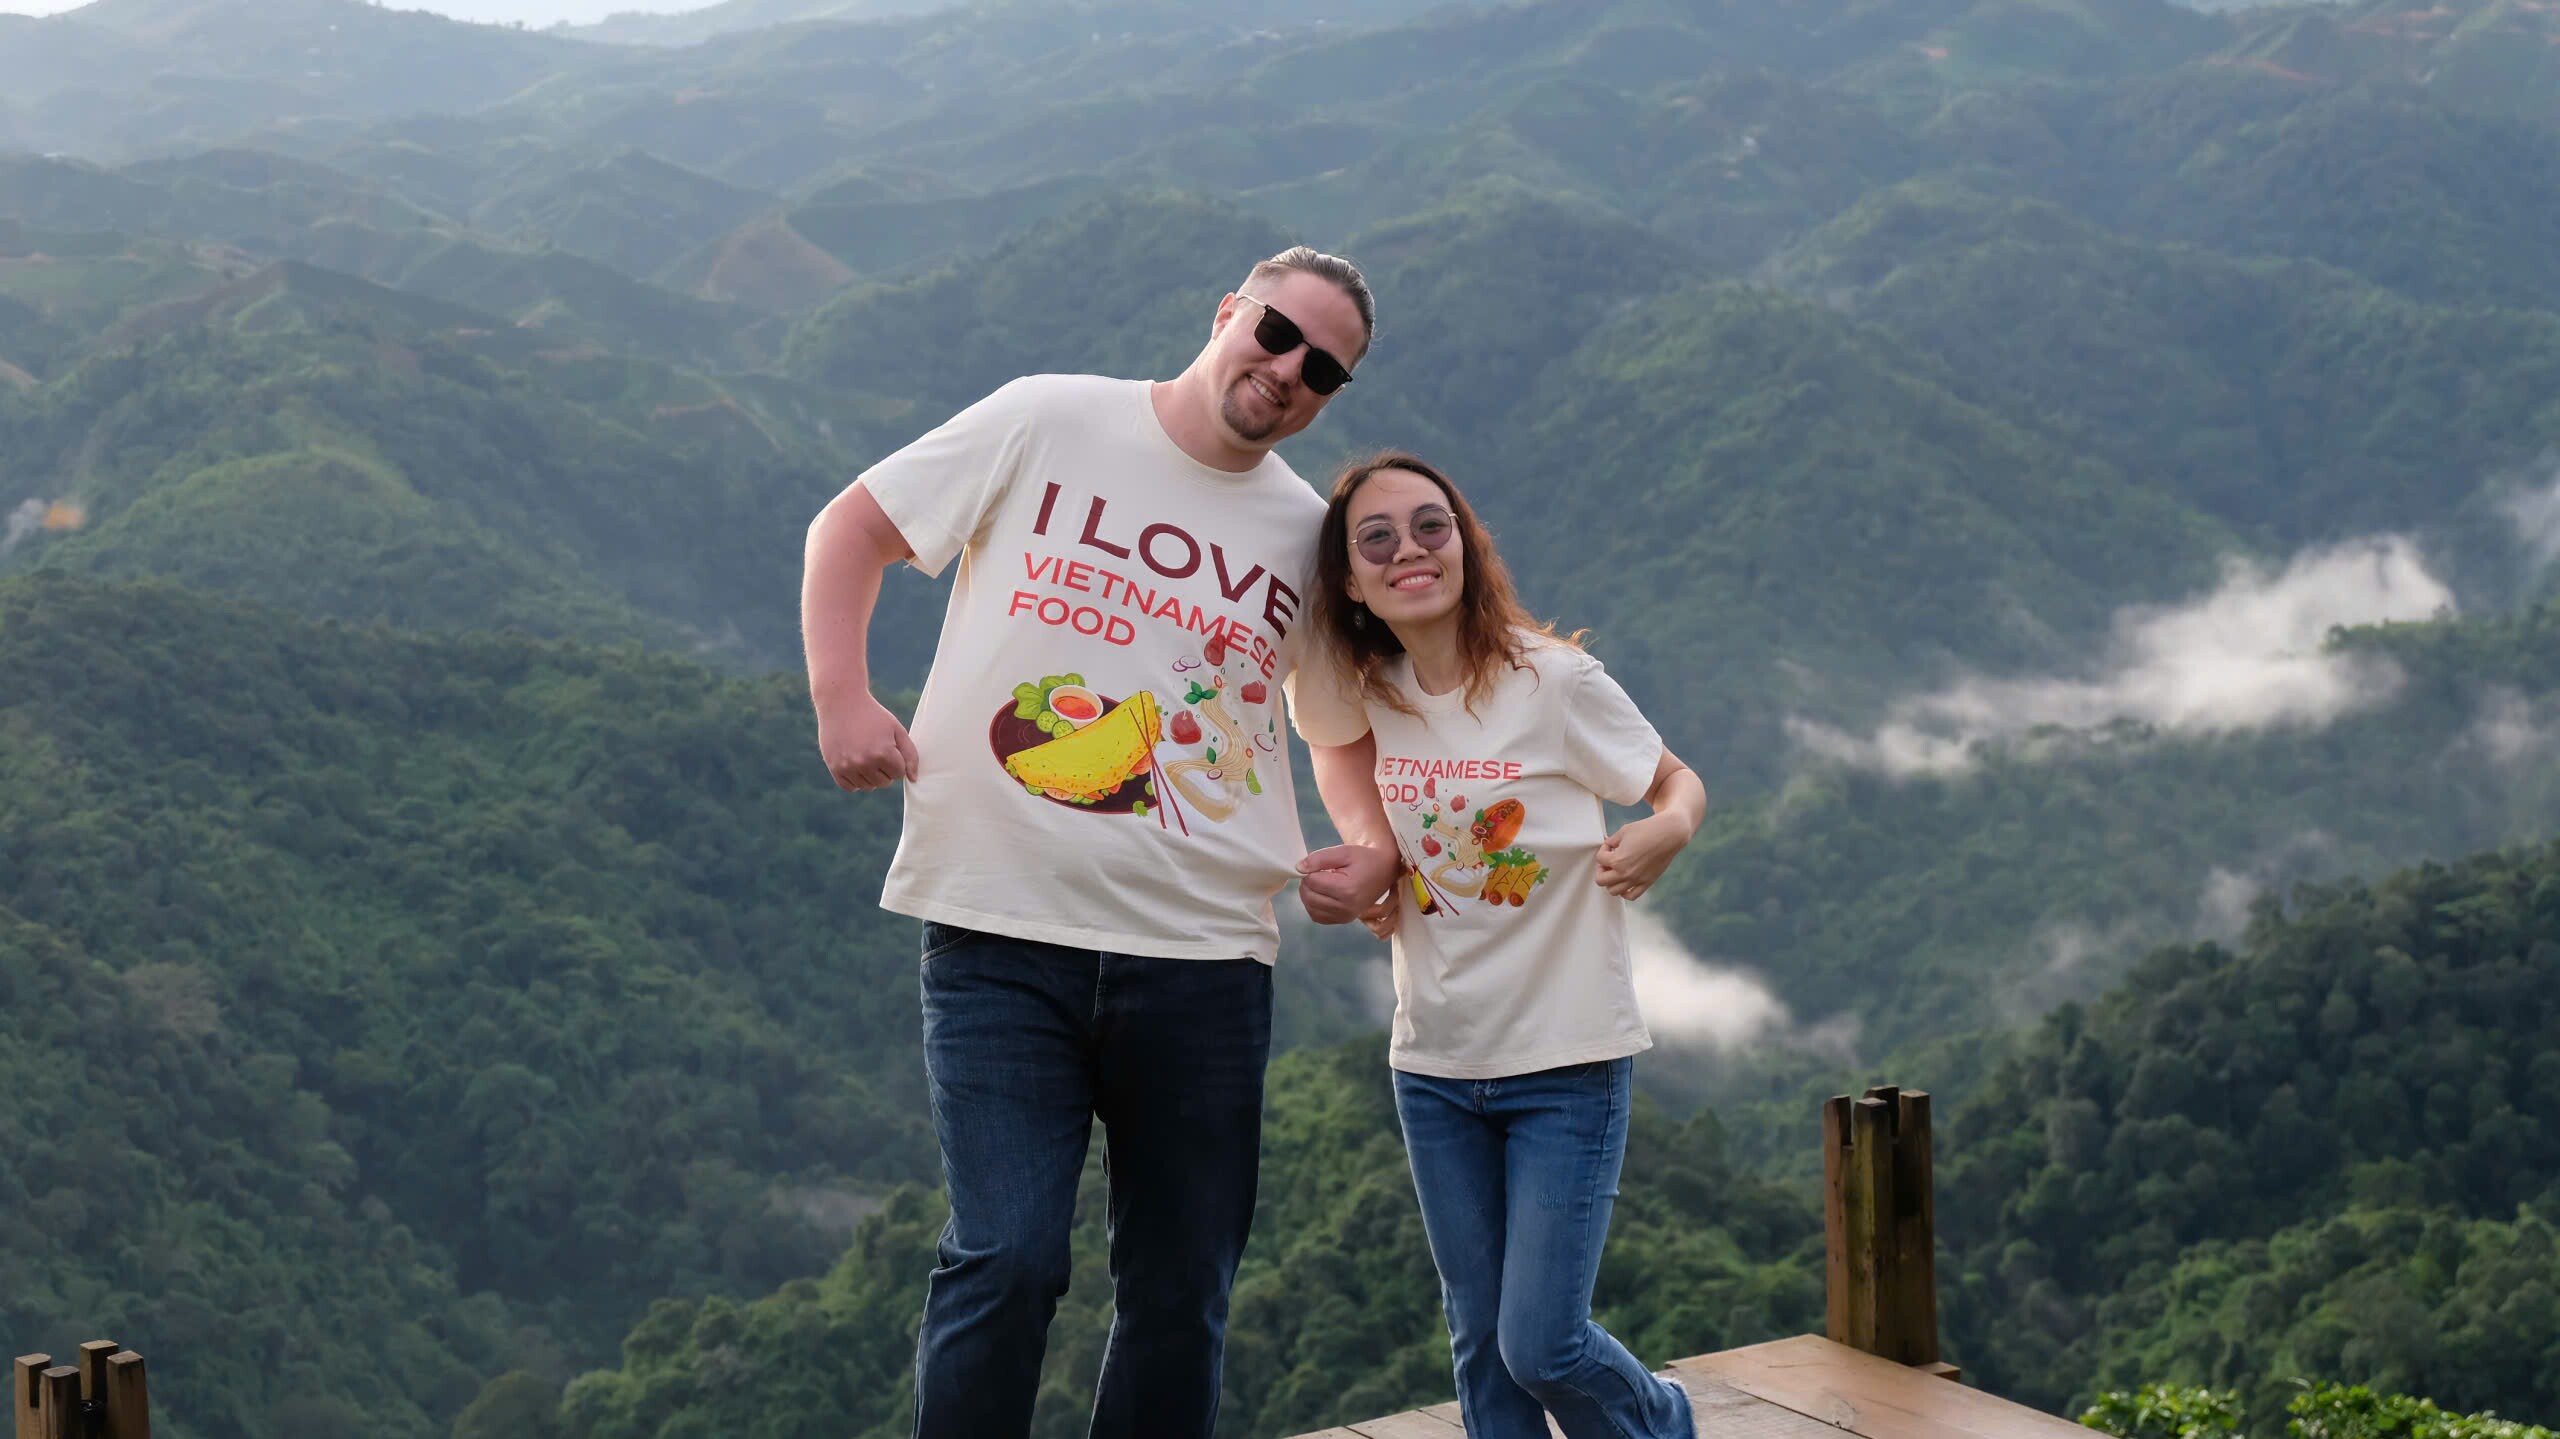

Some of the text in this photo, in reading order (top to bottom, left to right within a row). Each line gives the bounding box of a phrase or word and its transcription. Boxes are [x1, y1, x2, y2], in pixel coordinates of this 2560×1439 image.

[1008, 591, 1136, 646] FOOD
[1024, 552, 1277, 679] VIETNAMESE
[1032, 481, 1300, 640] I LOVE
